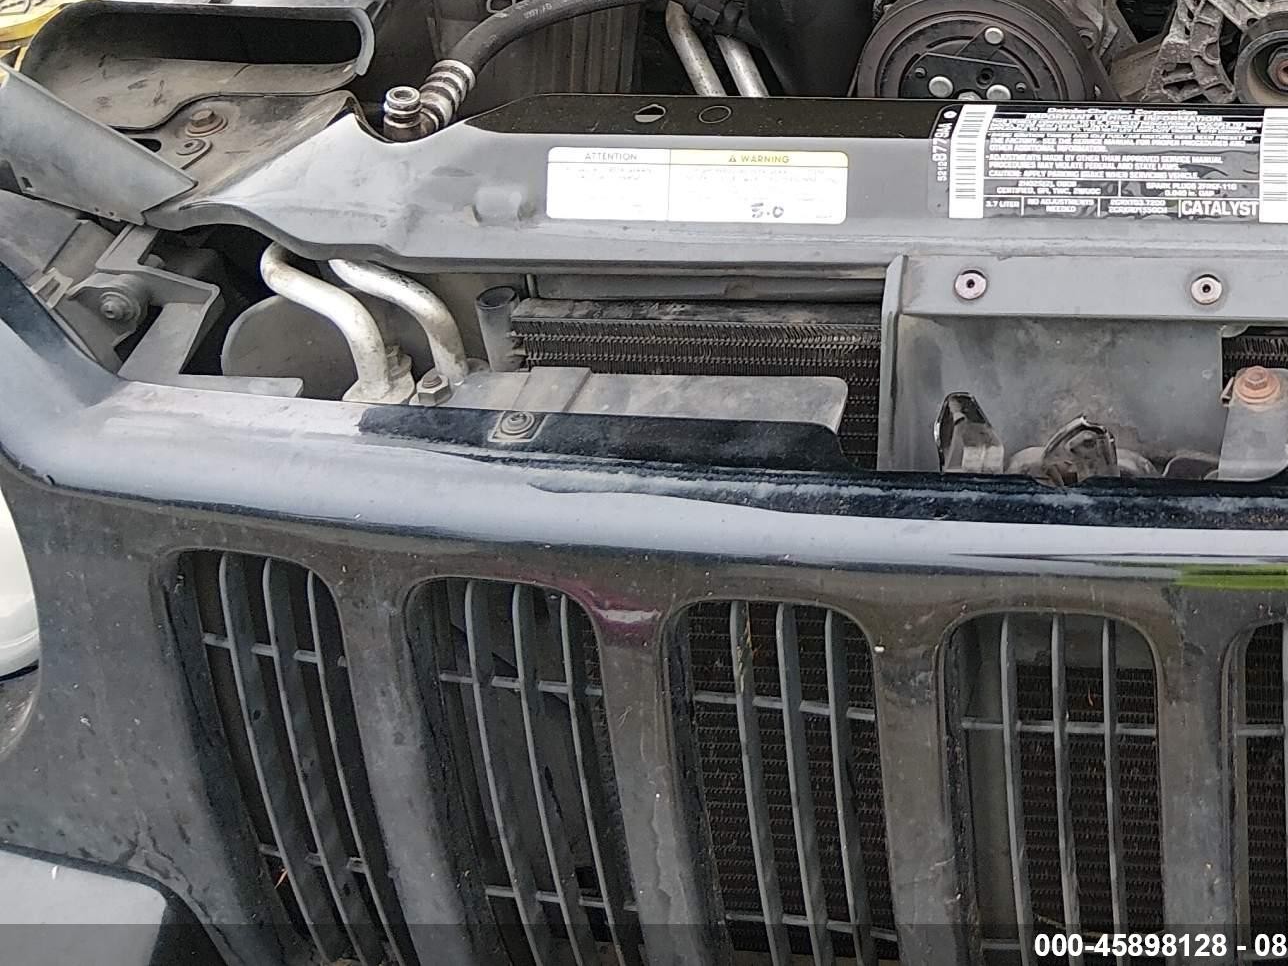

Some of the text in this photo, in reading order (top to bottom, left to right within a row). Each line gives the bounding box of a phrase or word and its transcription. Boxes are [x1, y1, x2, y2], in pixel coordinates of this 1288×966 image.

[1026, 114, 1223, 122] IMPORTANT VEHICLE INFORMATION
[584, 152, 637, 161] ATTENTION
[741, 155, 790, 164] WARNING
[1145, 182, 1172, 190] SPARK
[1172, 183, 1197, 191] PLUGS
[999, 200, 1020, 208] LITER
[1027, 198, 1095, 207] NO ADJUSTMENTS
[1045, 205, 1077, 213] NEEDED
[1181, 200, 1259, 216] CATALYST
